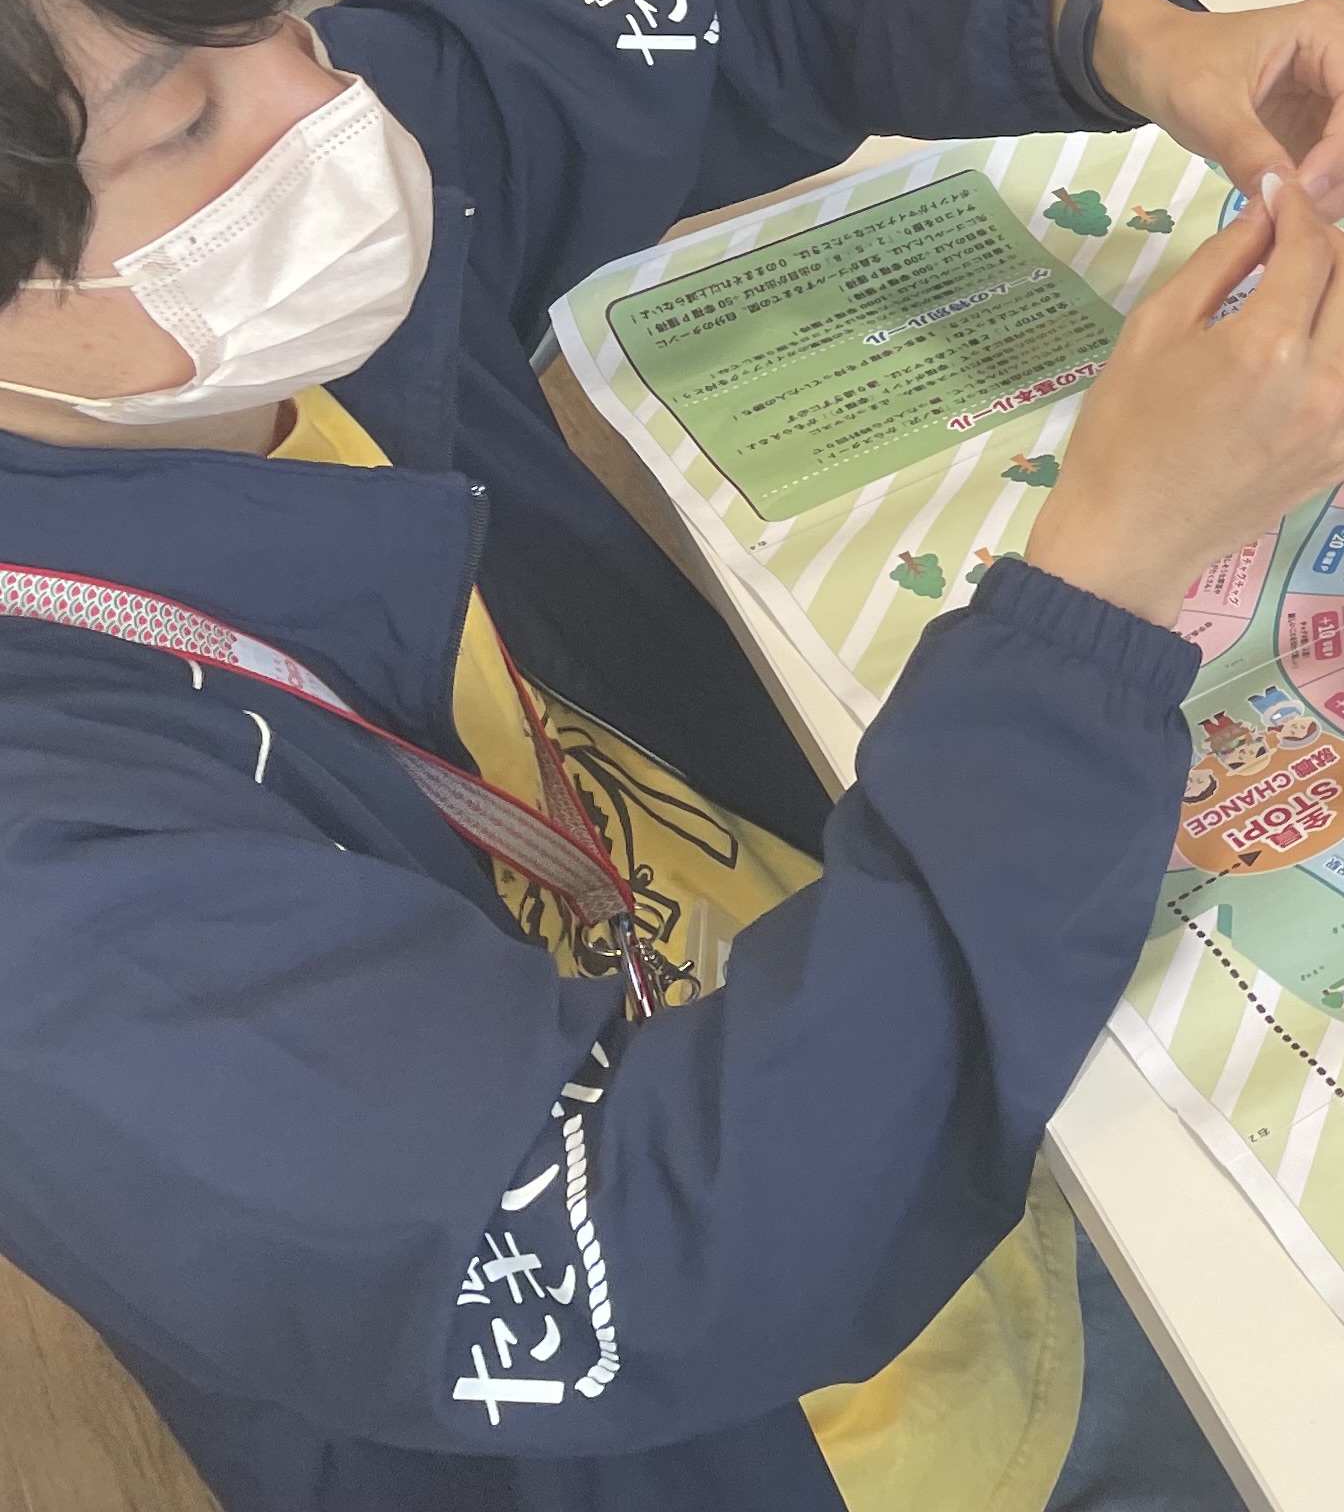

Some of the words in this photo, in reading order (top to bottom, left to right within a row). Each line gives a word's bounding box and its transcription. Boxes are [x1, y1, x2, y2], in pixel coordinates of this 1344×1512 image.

[863, 263, 1051, 348] ゲームの特別ルール
[1289, 746, 1338, 782] 就職
[1183, 769, 1294, 837] CHANCE
[1221, 777, 1341, 852] STOP!
[1263, 803, 1334, 852] 全員
